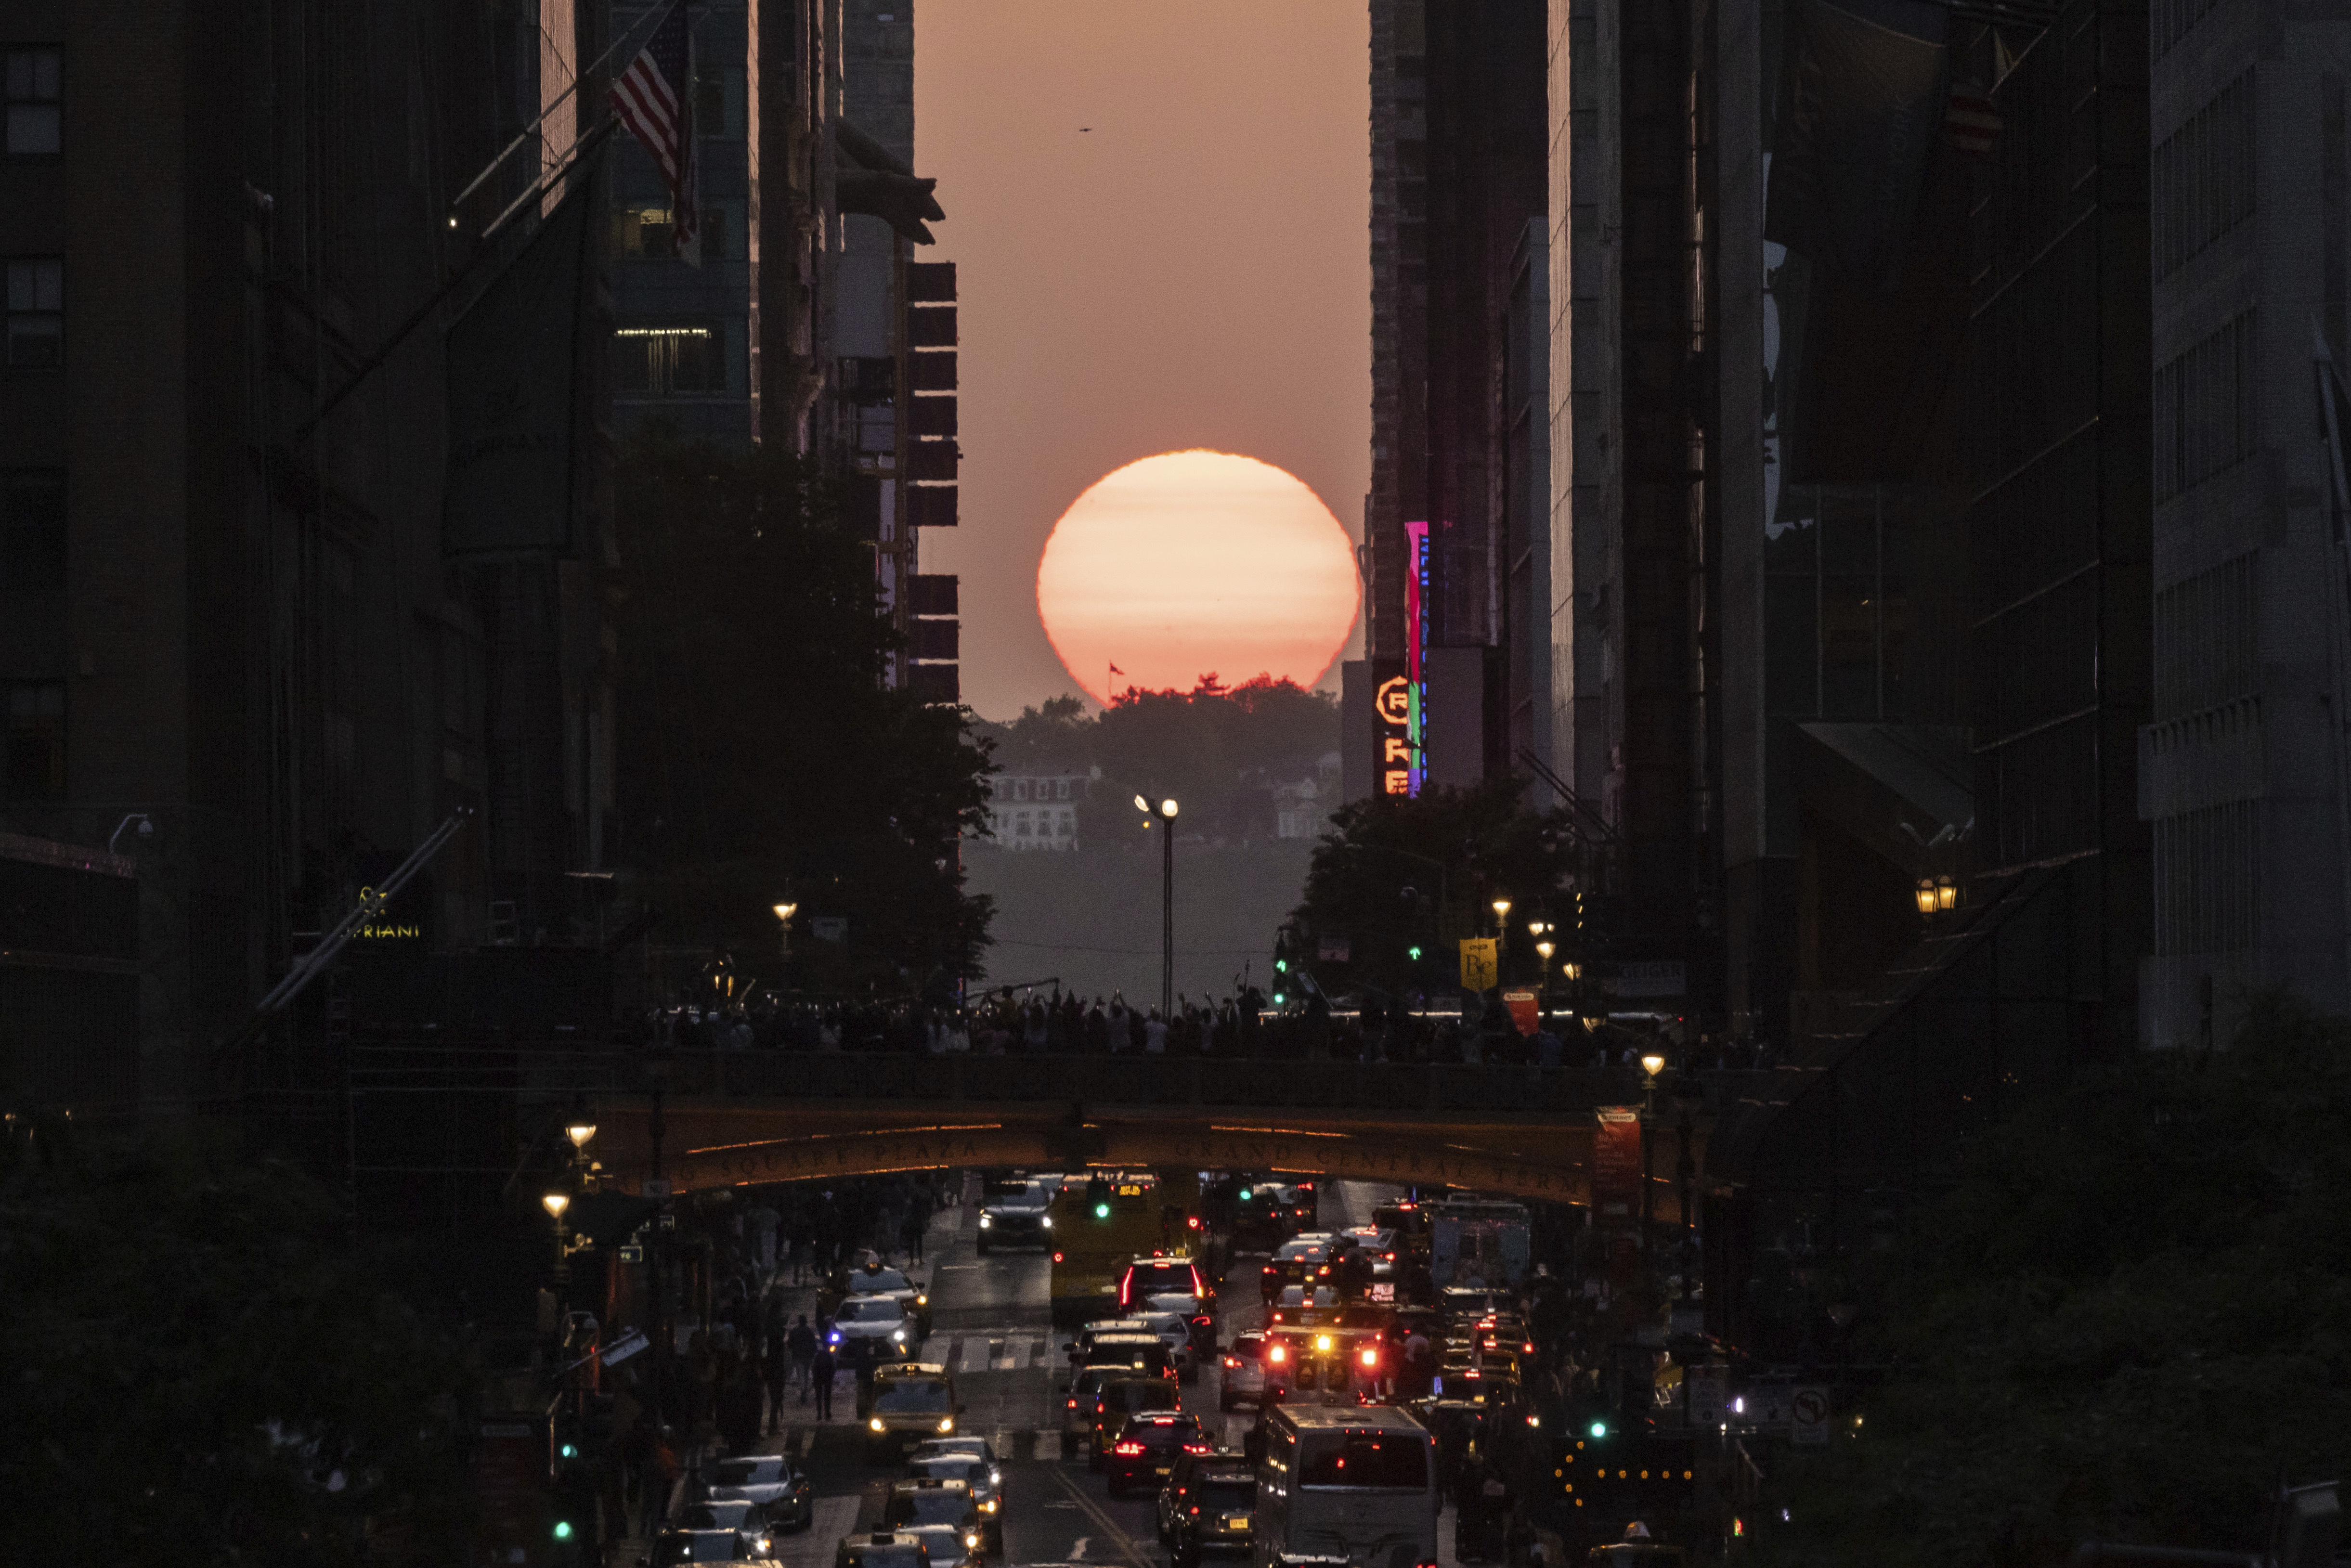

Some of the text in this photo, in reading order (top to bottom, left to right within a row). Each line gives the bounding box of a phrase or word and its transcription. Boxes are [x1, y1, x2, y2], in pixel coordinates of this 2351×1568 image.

[874, 1137, 977, 1162] PLAZA
[1176, 1141, 1579, 1194] GRAND CENTRAL TERM
